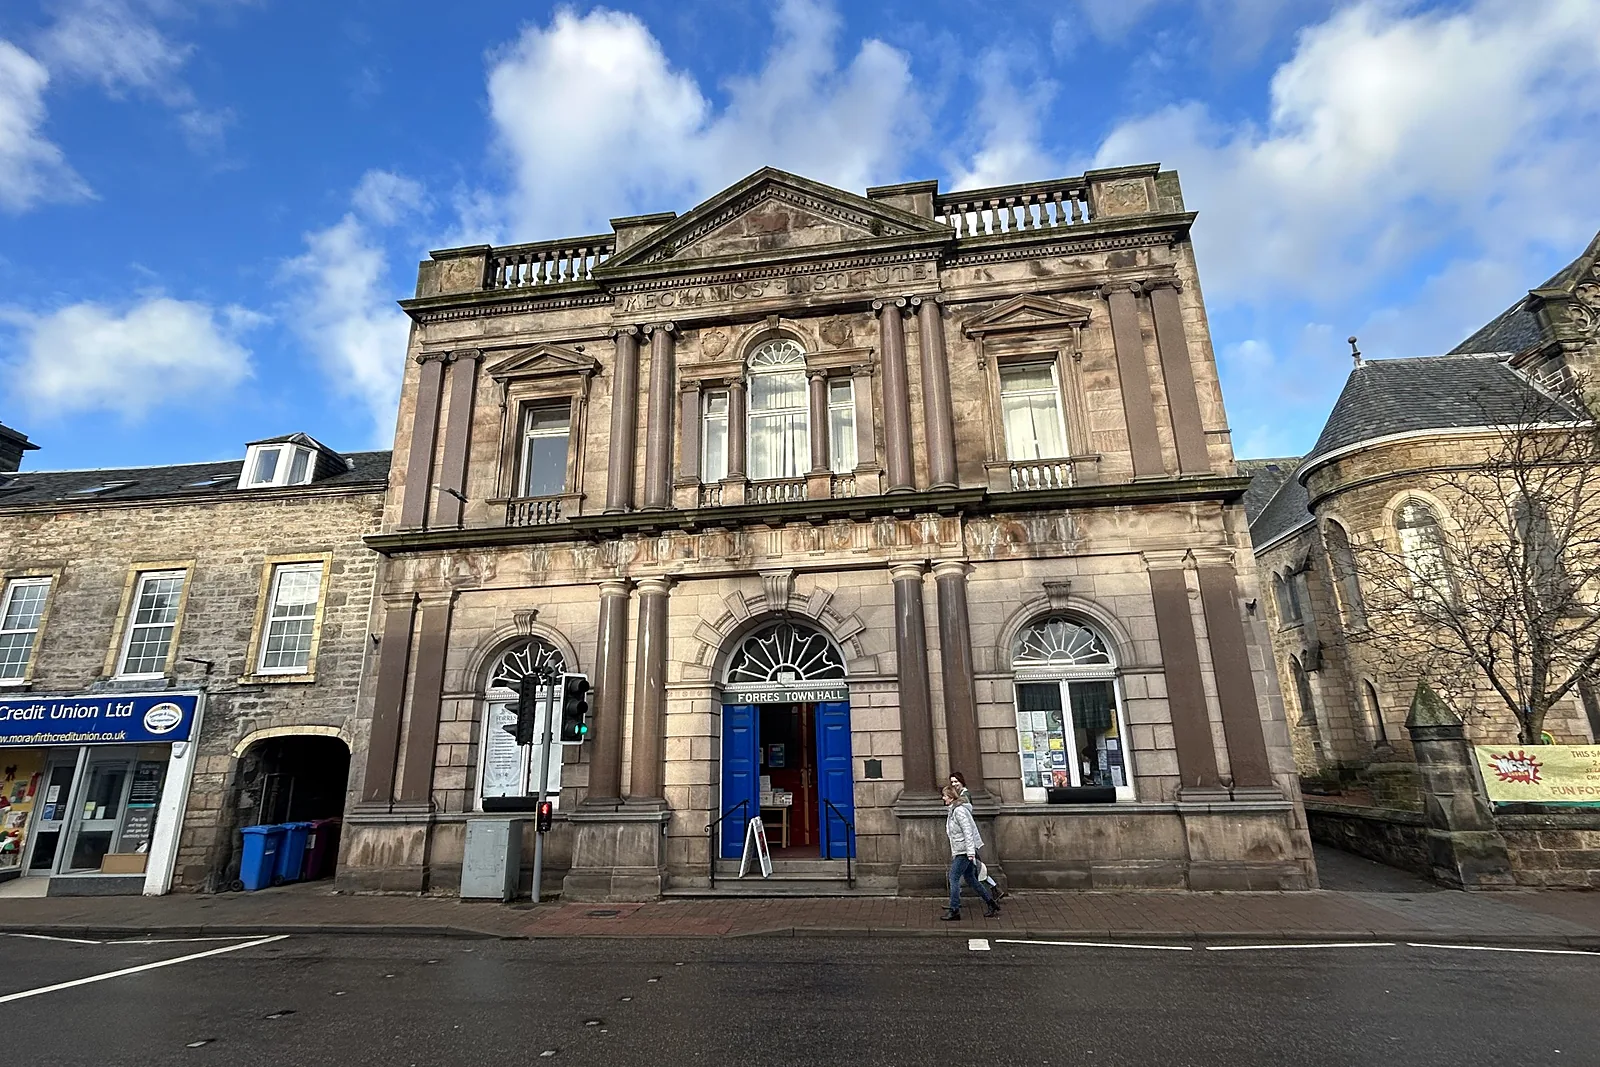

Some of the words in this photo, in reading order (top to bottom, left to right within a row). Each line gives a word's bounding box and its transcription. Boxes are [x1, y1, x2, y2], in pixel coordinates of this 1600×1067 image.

[787, 264, 926, 294] INSTITUTE
[738, 693, 780, 702] FORRES
[785, 692, 815, 701] TOWN
[817, 691, 844, 700] HALL
[0, 704, 46, 720] Credit
[51, 703, 99, 719] Union
[105, 701, 134, 717] Ltd
[1571, 750, 1590, 758] THIS
[1550, 786, 1576, 795] FUN
